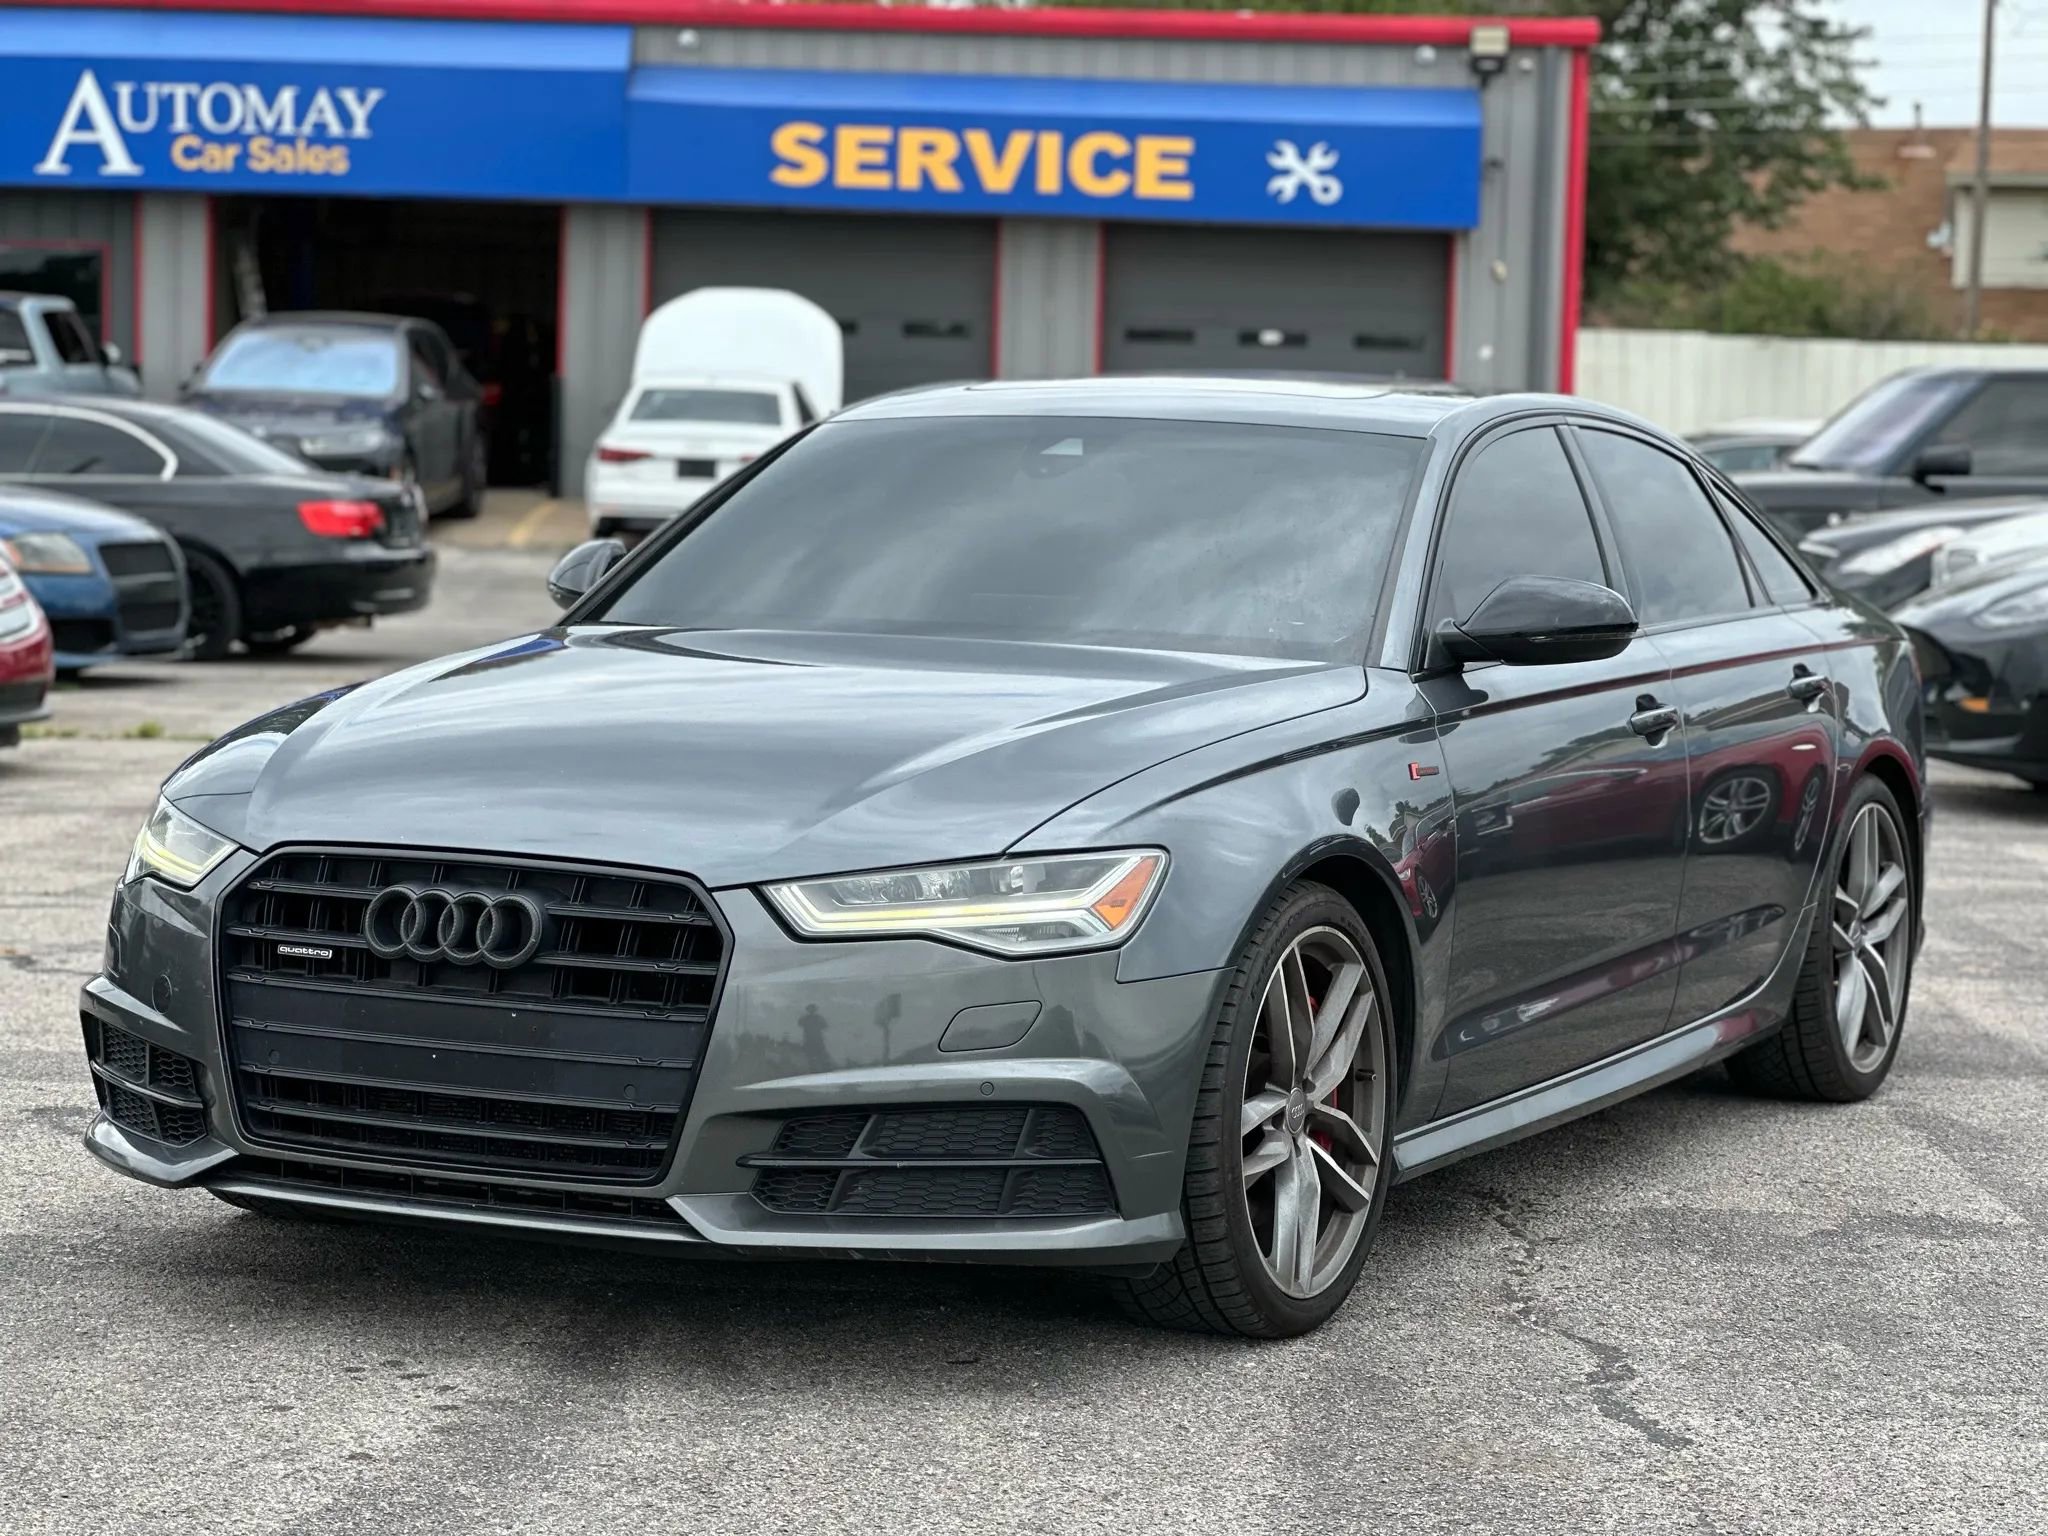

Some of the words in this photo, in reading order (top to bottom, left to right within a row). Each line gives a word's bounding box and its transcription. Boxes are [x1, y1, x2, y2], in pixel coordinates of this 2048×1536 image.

[33, 68, 386, 177] AUTOMAY
[170, 133, 241, 173] Car
[246, 136, 350, 176] Sales
[769, 121, 1196, 201] SERVICE
[279, 946, 329, 957] quattro
